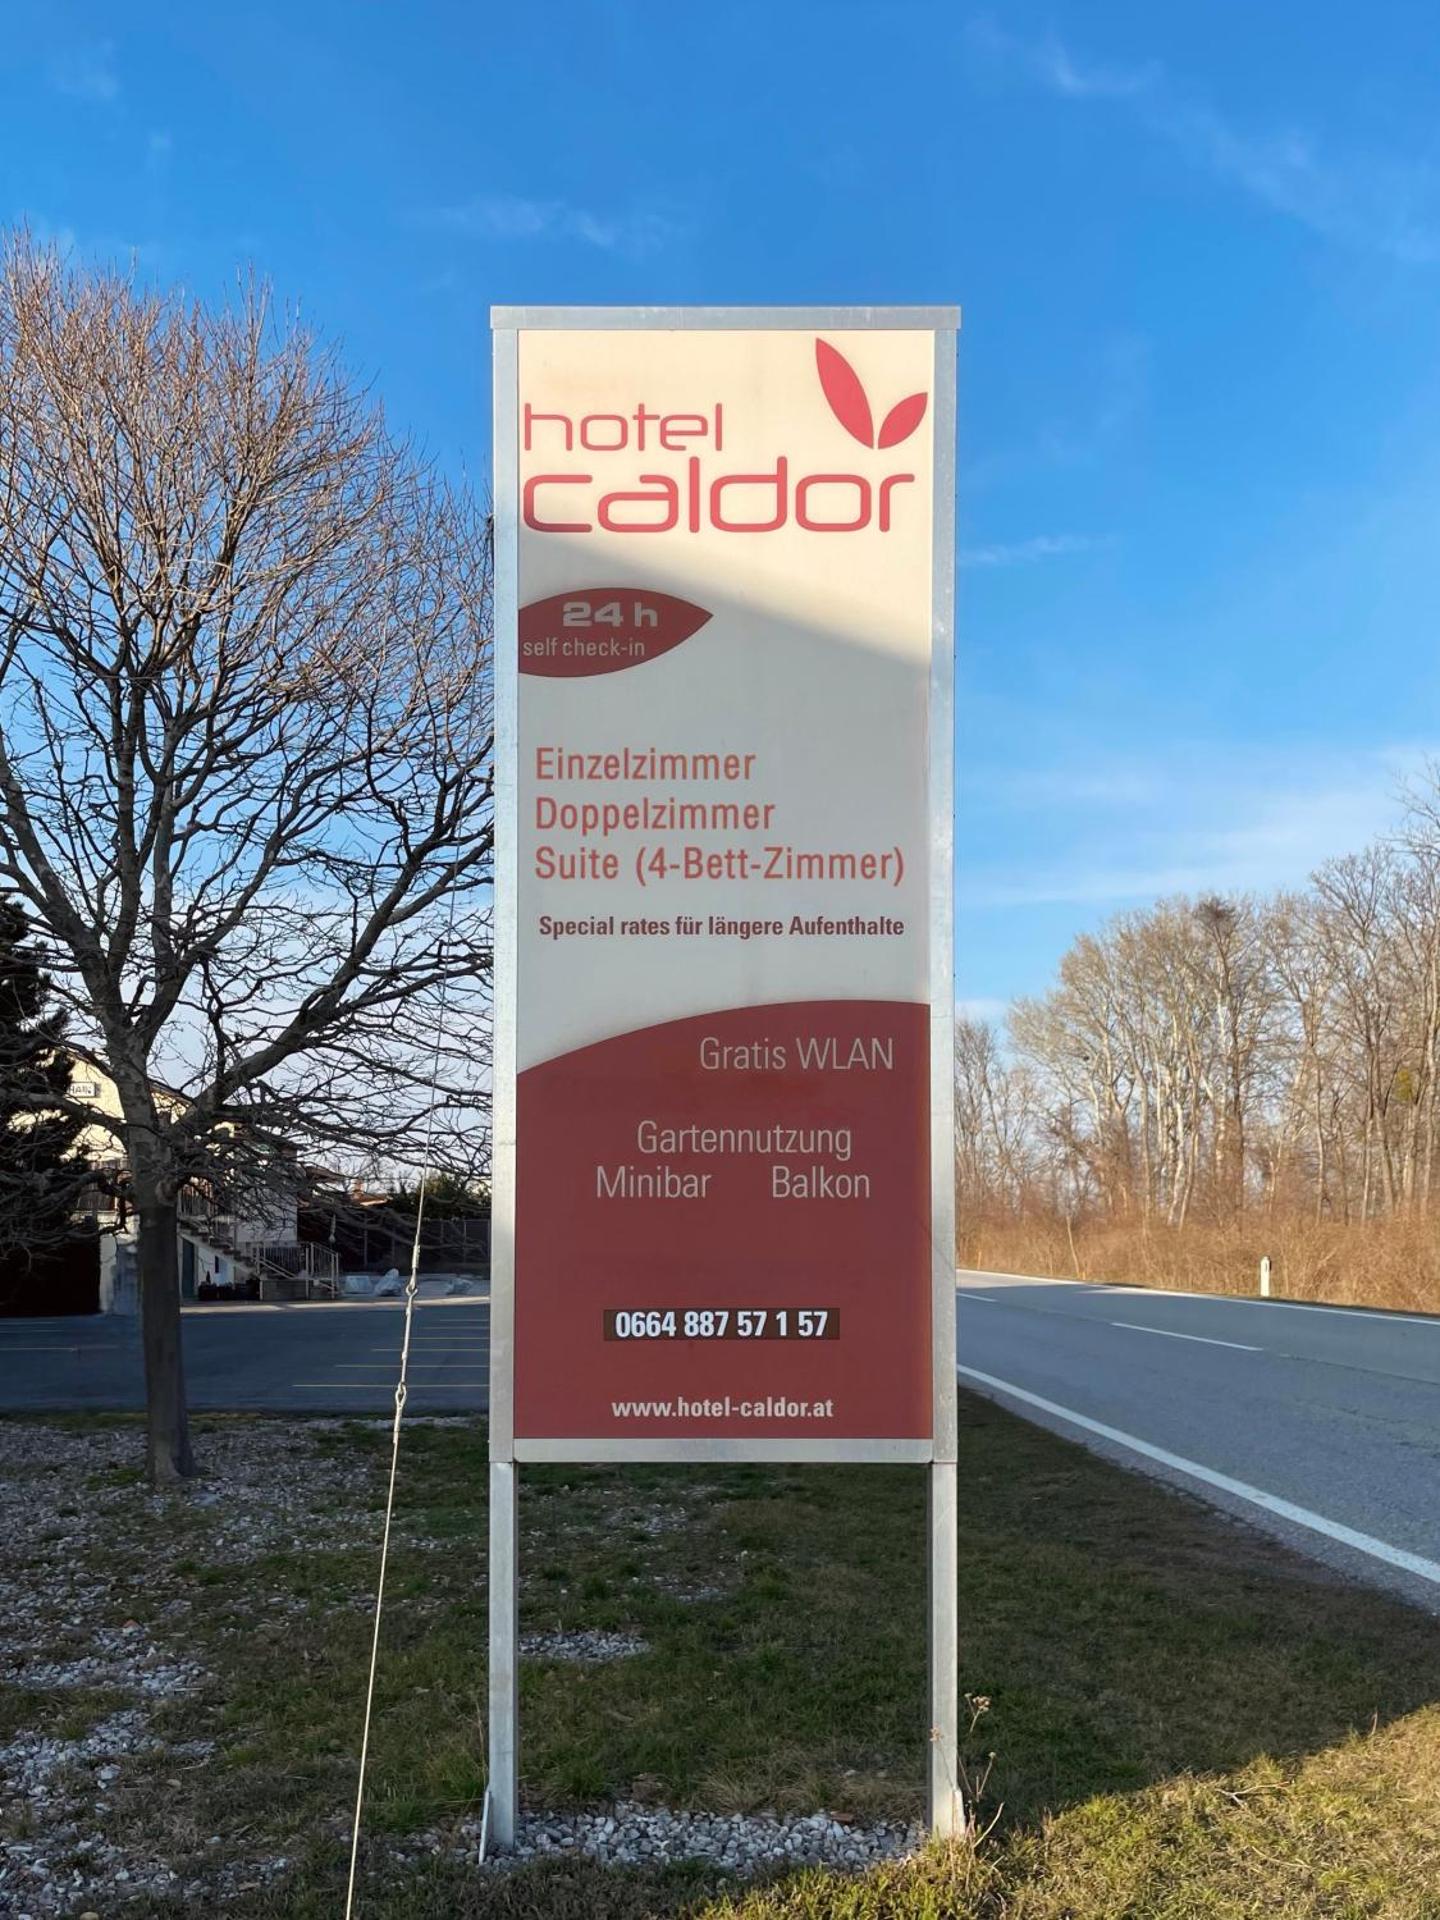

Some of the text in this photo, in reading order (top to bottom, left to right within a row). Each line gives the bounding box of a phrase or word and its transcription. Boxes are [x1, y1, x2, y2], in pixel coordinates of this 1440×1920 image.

[523, 402, 723, 452] hotel
[523, 456, 916, 533] caldor
[562, 601, 658, 628] 24 h
[522, 638, 646, 657] self check-in
[535, 747, 757, 780] Einzelzimmer
[535, 797, 776, 836] Doppelzimmer
[535, 846, 905, 886] Suite (4-Bett-Zimmer)
[539, 916, 905, 938] Special rates für längere Aufenthalte
[700, 1036, 894, 1070] Gratis WLAN
[637, 1120, 852, 1161] Gartennutzung
[596, 1165, 871, 1199] Minibar Balkon
[615, 1311, 829, 1338] 0664 887 57 1 57
[611, 1397, 834, 1418] www.hotel-caldor.at
